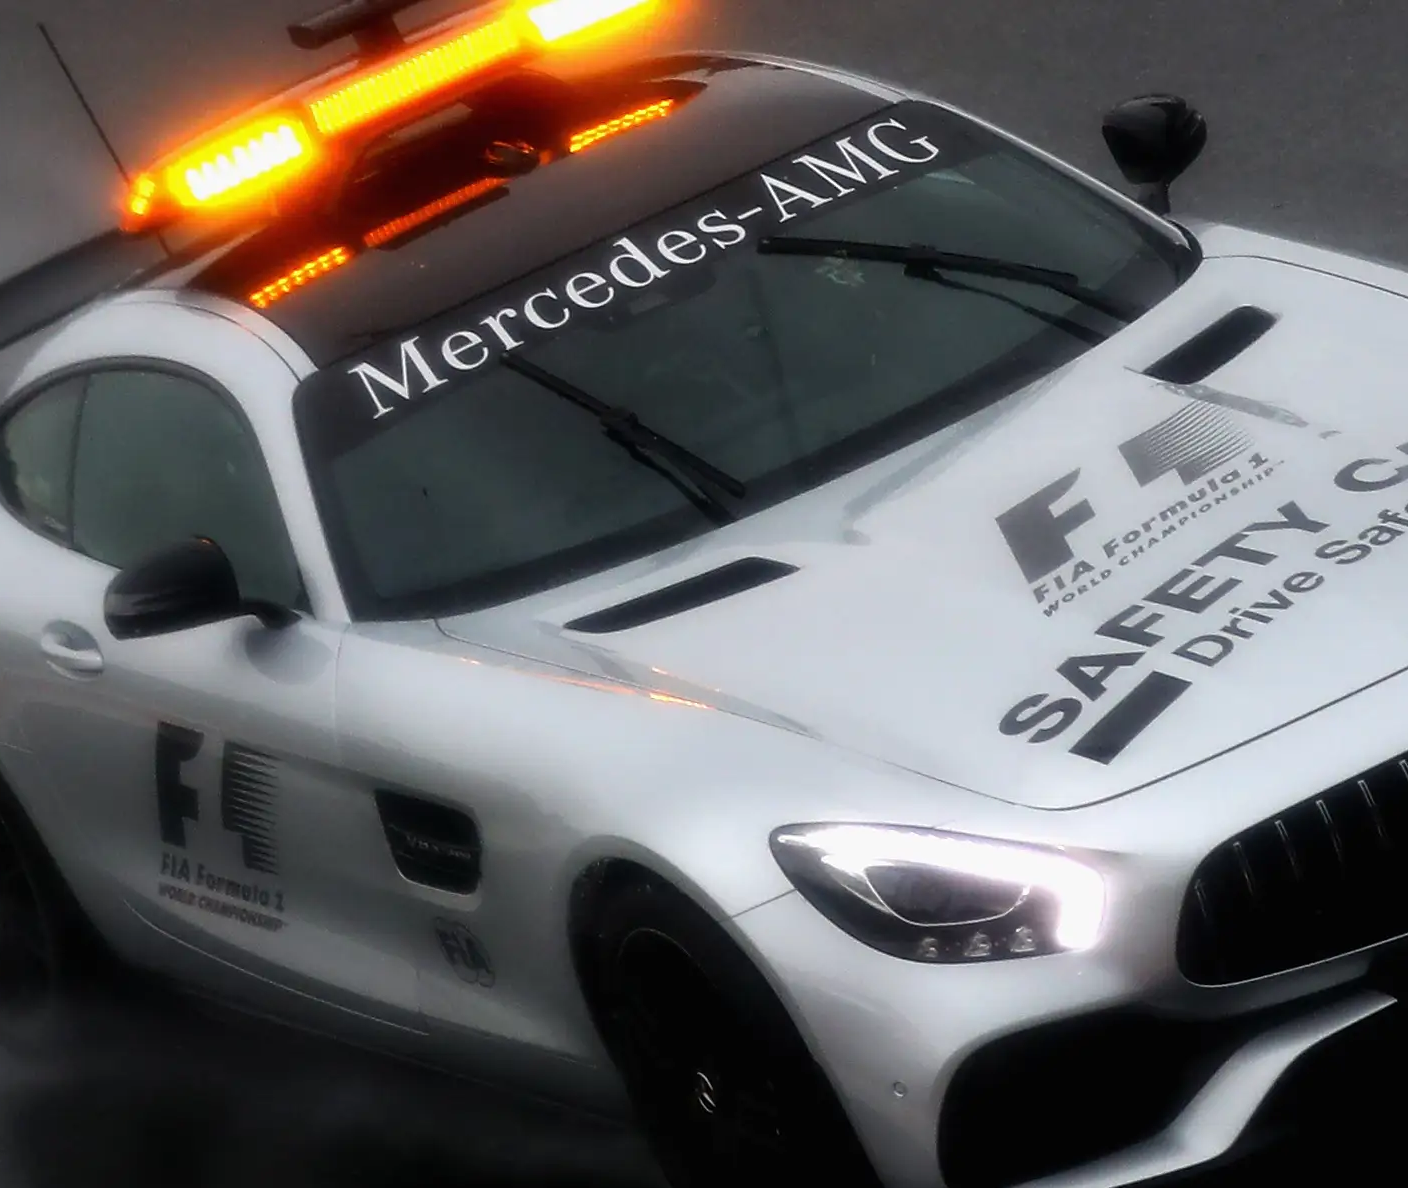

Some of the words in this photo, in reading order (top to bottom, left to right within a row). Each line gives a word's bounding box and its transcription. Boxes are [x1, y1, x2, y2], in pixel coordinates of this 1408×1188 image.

[347, 117, 940, 420] Mercedes-AMG
[1033, 559, 1096, 604] FIA
[1101, 468, 1242, 559] Formula
[1248, 452, 1269, 470] 1
[1043, 568, 1113, 618] WORLD
[1118, 466, 1275, 567] CHAMPIONSHIP
[998, 500, 1331, 744] SAFETY
[1172, 568, 1325, 668] Drive
[159, 850, 191, 884] FIA
[274, 889, 286, 913] 1
